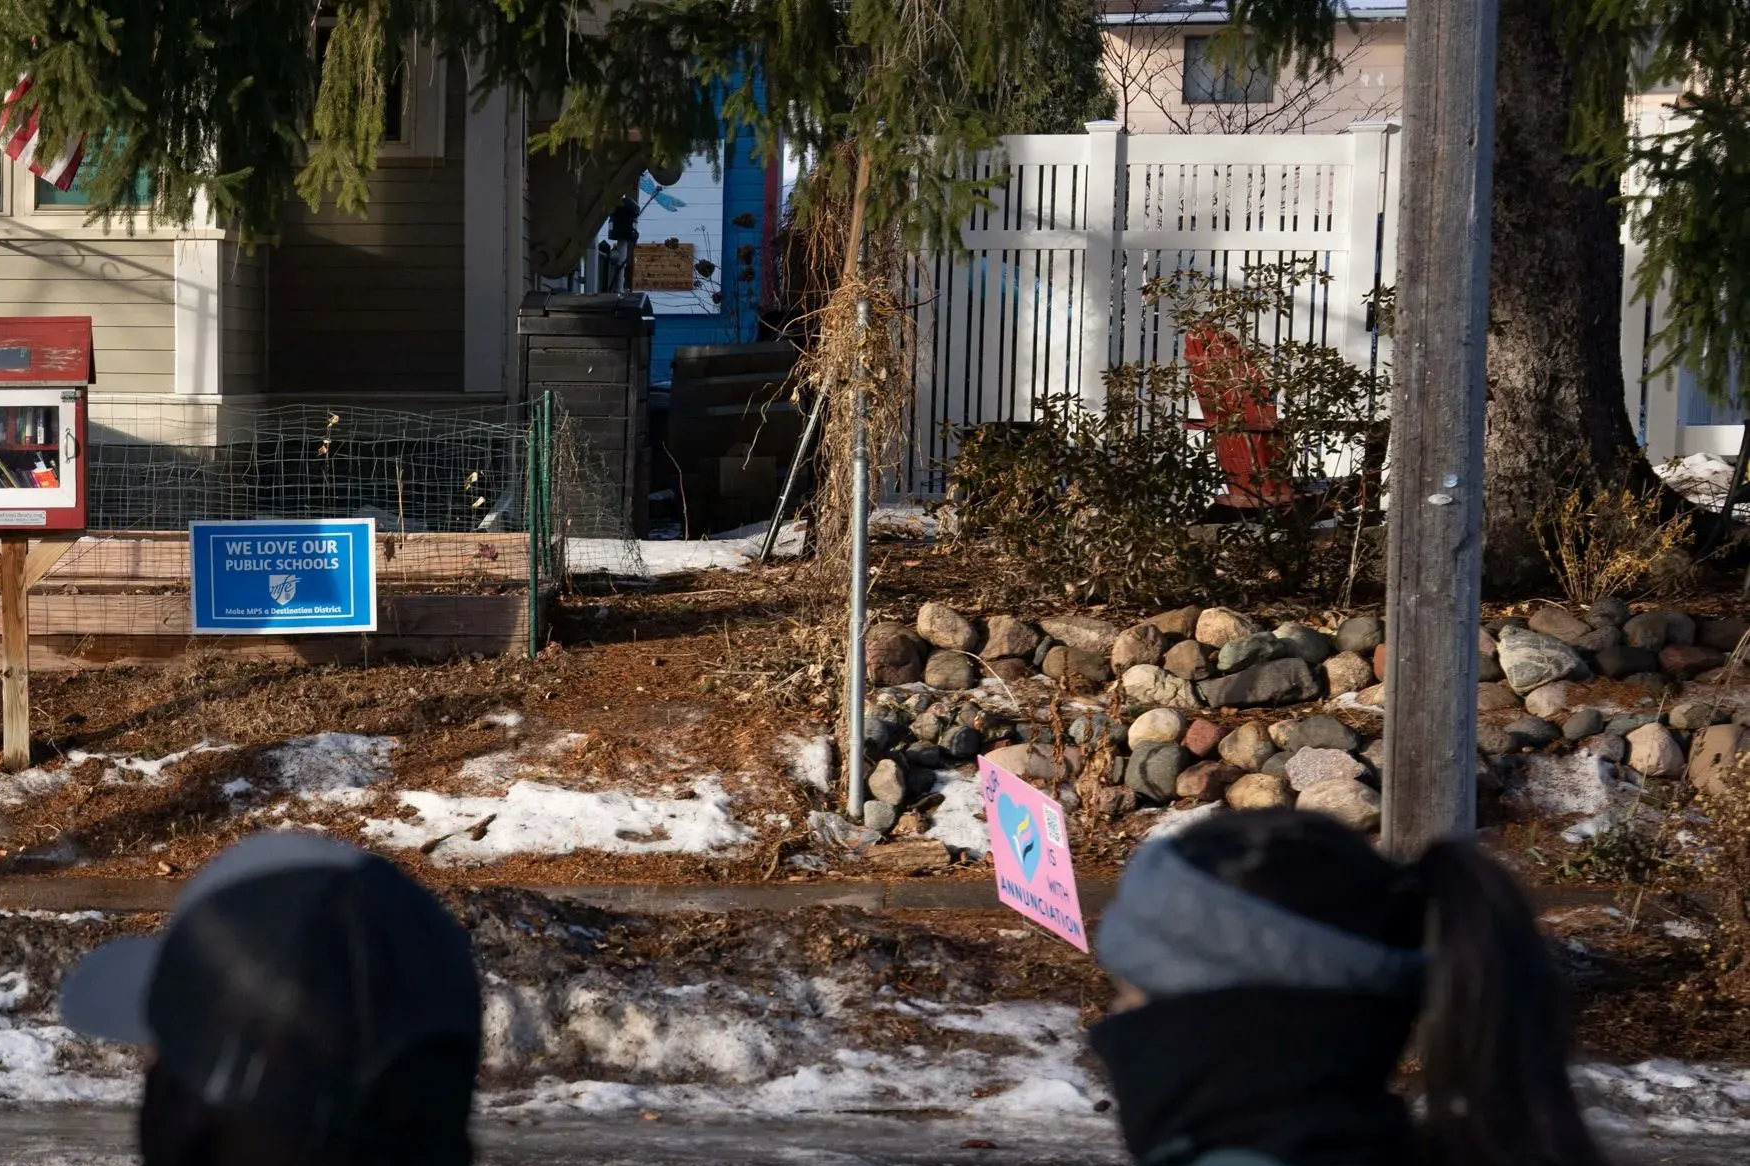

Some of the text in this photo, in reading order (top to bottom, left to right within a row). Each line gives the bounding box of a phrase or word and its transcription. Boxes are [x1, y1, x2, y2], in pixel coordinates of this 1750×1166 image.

[225, 539, 338, 555] WE LOVE OUR
[225, 557, 340, 571] PUBLIC SCHOOLS
[225, 607, 245, 615] Make
[246, 607, 263, 615] MPS
[270, 606, 313, 615] Destination
[313, 605, 342, 614] District
[985, 770, 1000, 802] OUR
[1047, 848, 1057, 867] IS
[1046, 874, 1070, 903] WITH
[1000, 875, 1082, 938] ANNUNCIATION
